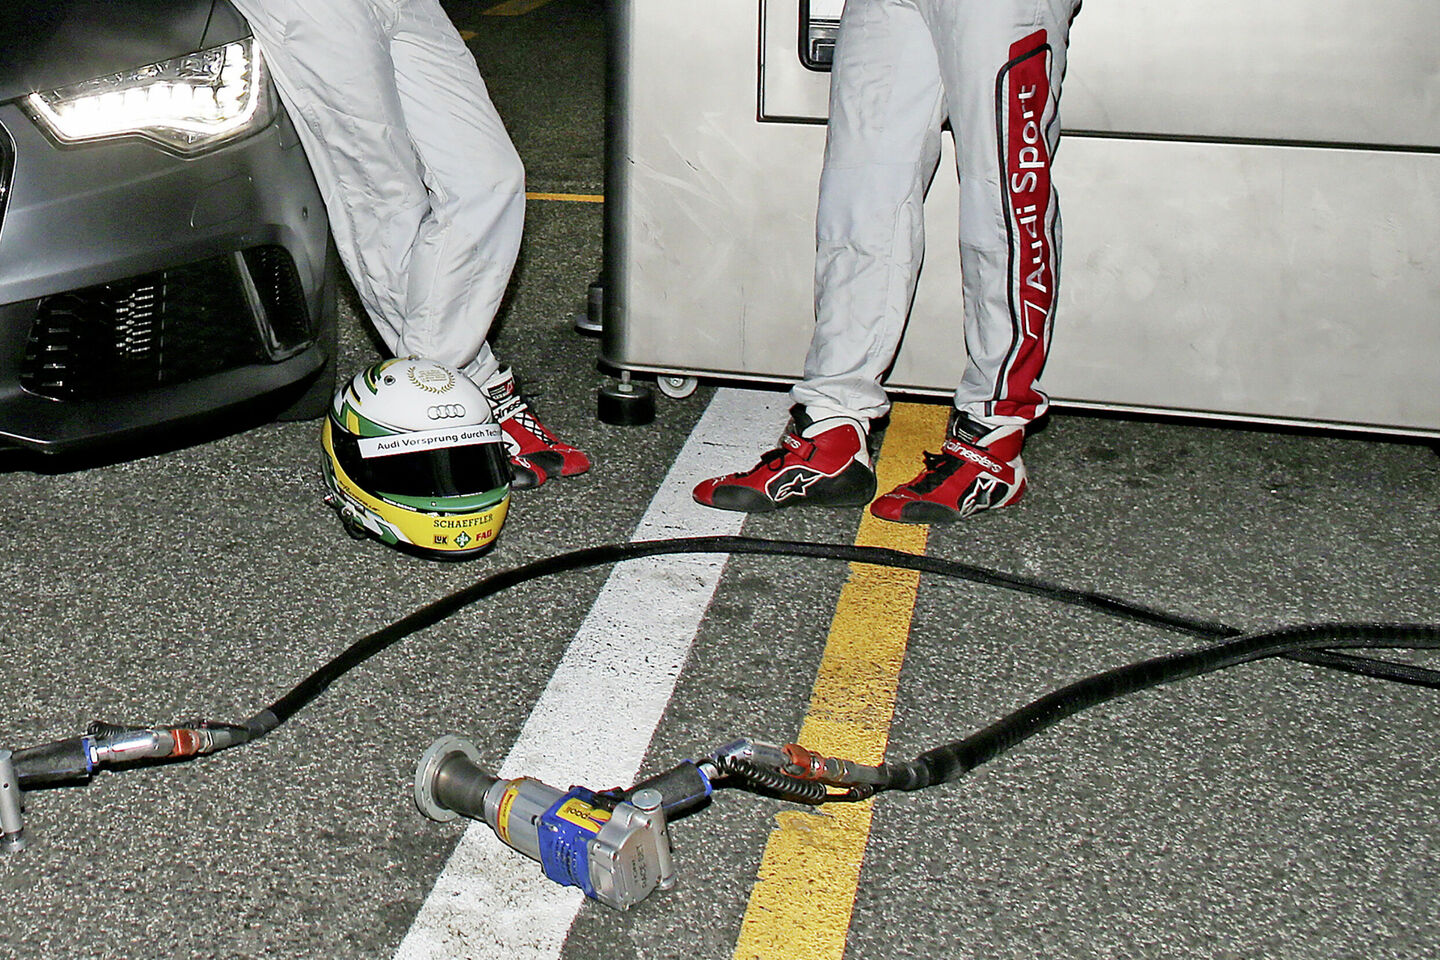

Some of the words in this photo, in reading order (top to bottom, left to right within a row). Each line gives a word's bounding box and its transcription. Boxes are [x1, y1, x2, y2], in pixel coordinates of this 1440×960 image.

[1010, 84, 1046, 194] Sport
[1013, 204, 1047, 294] Audi
[376, 441, 400, 451] Audi
[401, 434, 459, 447] Vorsprung
[460, 429, 485, 440] durch
[433, 513, 494, 529] SCHAEFFLER
